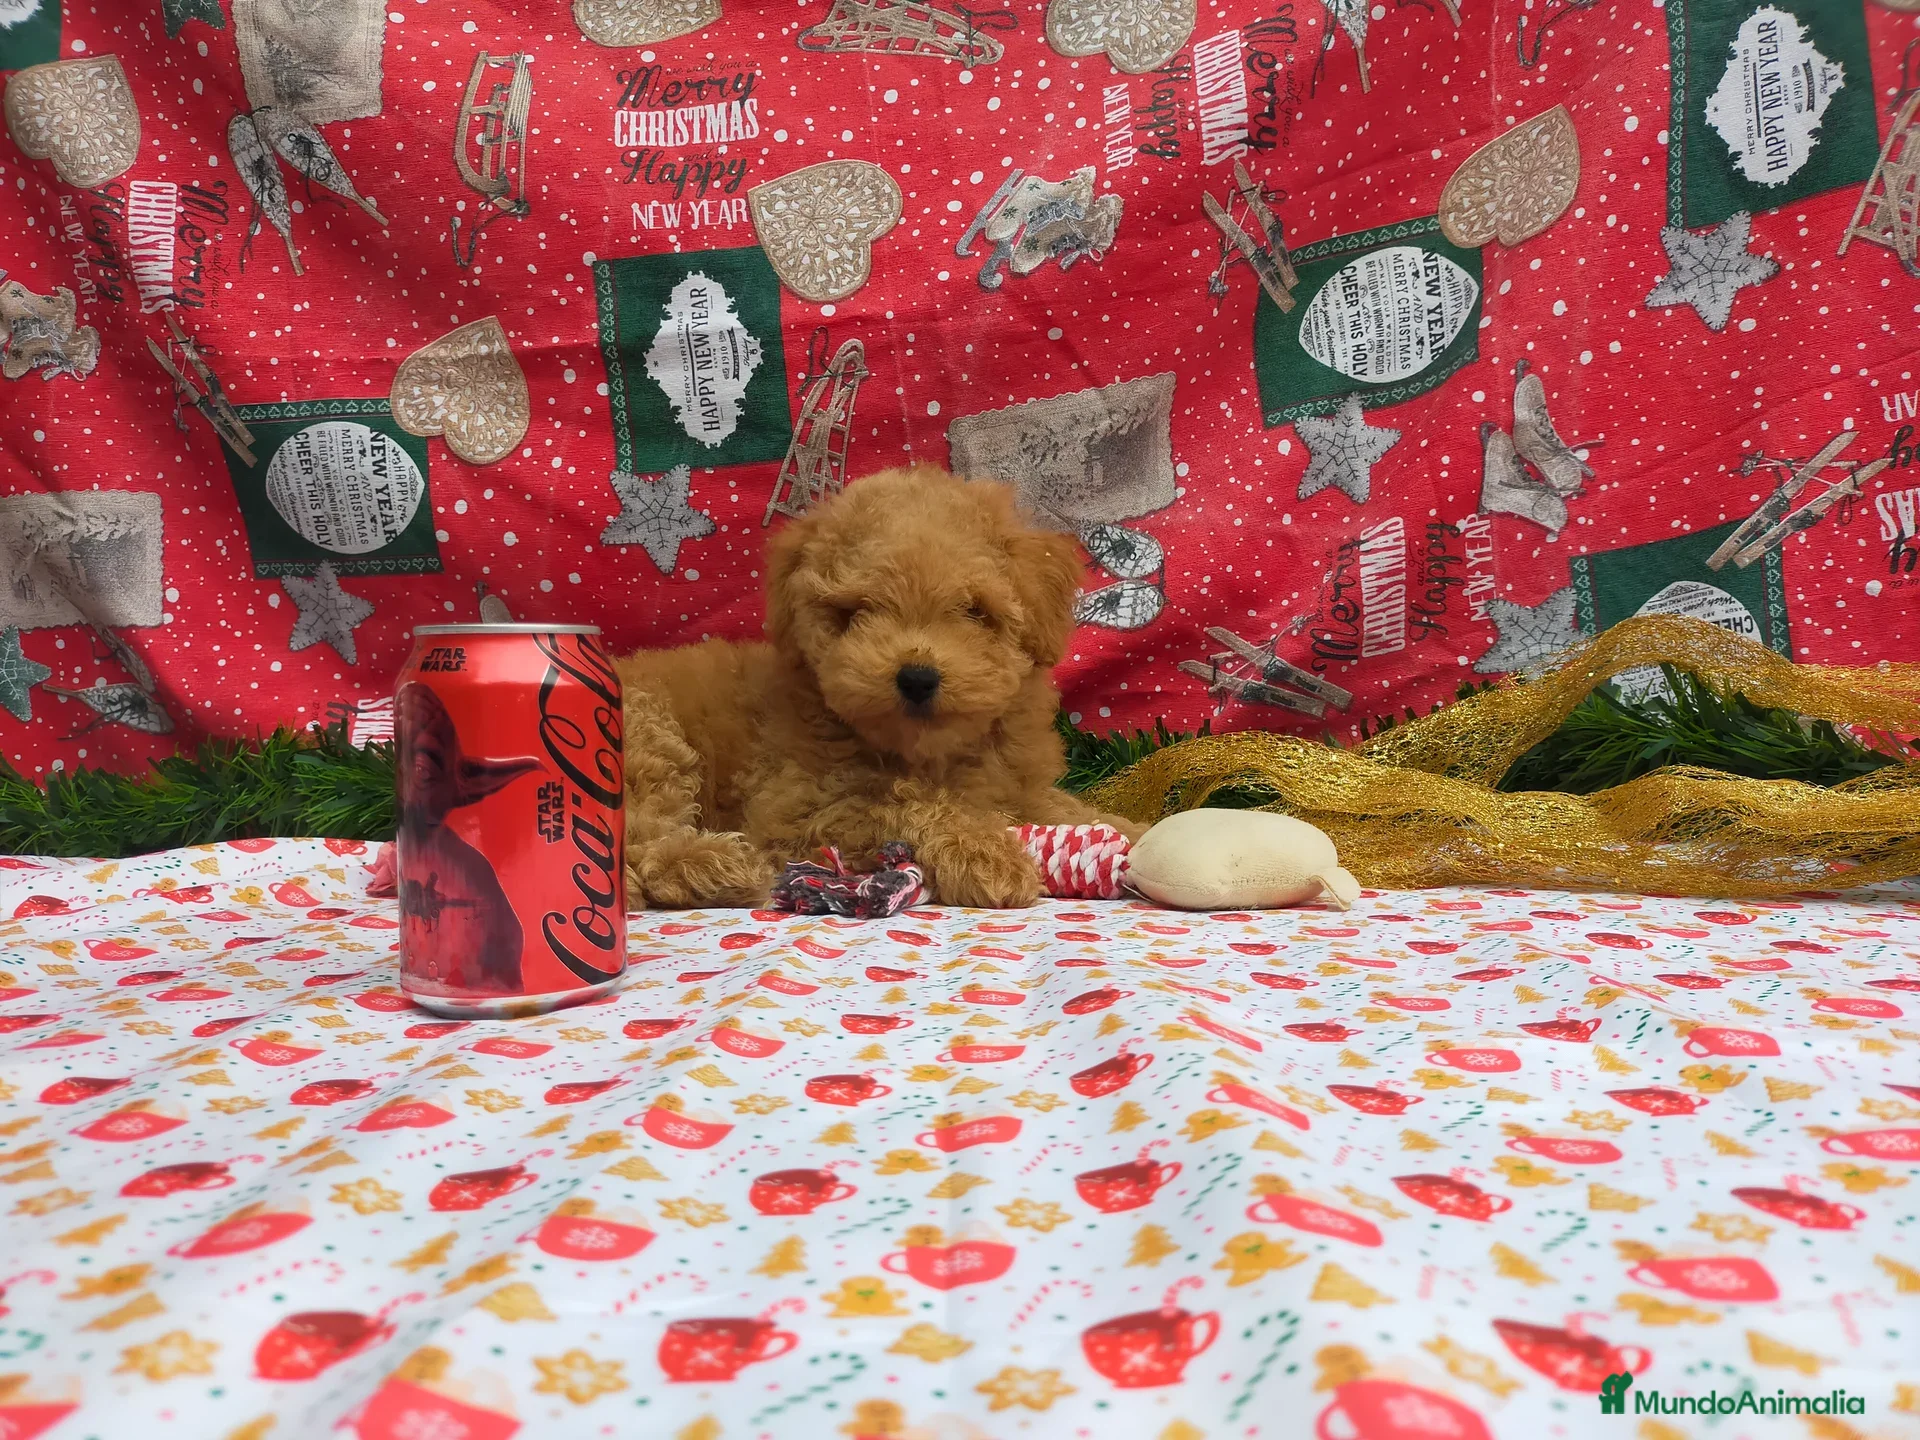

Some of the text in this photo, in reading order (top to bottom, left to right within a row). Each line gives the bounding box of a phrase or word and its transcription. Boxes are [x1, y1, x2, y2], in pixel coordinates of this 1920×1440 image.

[616, 65, 760, 111] Merry
[745, 60, 757, 68] a
[1238, 4, 1298, 156] Merry
[1793, 79, 1804, 100] 1910
[614, 98, 760, 147] CHRISTMAS
[1134, 54, 1191, 163] Happy
[1193, 29, 1249, 167] CHRISTMAS
[1742, 48, 1756, 155] MERRY CHRISTMAS
[1757, 19, 1789, 173] HAPPY NEW YEAR
[683, 145, 714, 162] and
[1103, 83, 1136, 173] NEW YEAR
[1282, 140, 1291, 149] a
[621, 148, 751, 200] Happy
[86, 183, 126, 303] Happy
[632, 198, 748, 230] NEW YEAR
[59, 194, 99, 305] NEW YEAR
[128, 180, 178, 314] CHRISTMAS
[170, 180, 229, 311] Merry
[1380, 273, 1388, 290] MAY
[1383, 294, 1391, 319] YOUR
[1393, 253, 1411, 371] MERRY CHRISTMAS
[1413, 294, 1424, 324] AND
[1422, 249, 1448, 361] NEW YEAR
[1448, 281, 1463, 317] HAPPY
[1339, 266, 1368, 377] CHEER THIS HOLY
[1365, 260, 1385, 375] BE FILLED WITH WARMTH AND GOOD
[677, 311, 692, 412] MERRY CHRISTMAS
[690, 287, 721, 432] HAPPY NEW YEAR
[720, 346, 730, 366] 1910
[317, 430, 326, 439] BE
[1880, 390, 1920, 422] AR
[318, 441, 329, 462] FILLED
[322, 462, 332, 480] WITH
[294, 432, 333, 547] CHEER THIS HOLY
[326, 480, 339, 513] WARMTH
[332, 469, 341, 494] YOUR
[339, 499, 349, 531] WORLD
[341, 429, 369, 545] MERRY CHRISTMAS
[360, 472, 373, 502] AND
[370, 428, 398, 544] NEW YEAR
[396, 466, 408, 503] HAPPY
[332, 512, 341, 527] AND
[1310, 539, 1371, 671] Merry
[1359, 516, 1406, 658] CHRISTMAS
[1408, 519, 1464, 642] Happy
[1464, 574, 1496, 622] NEW
[420, 660, 462, 673] WARS
[425, 647, 467, 660] STAR
[537, 781, 552, 843] STAR
[552, 781, 565, 843] WARS
